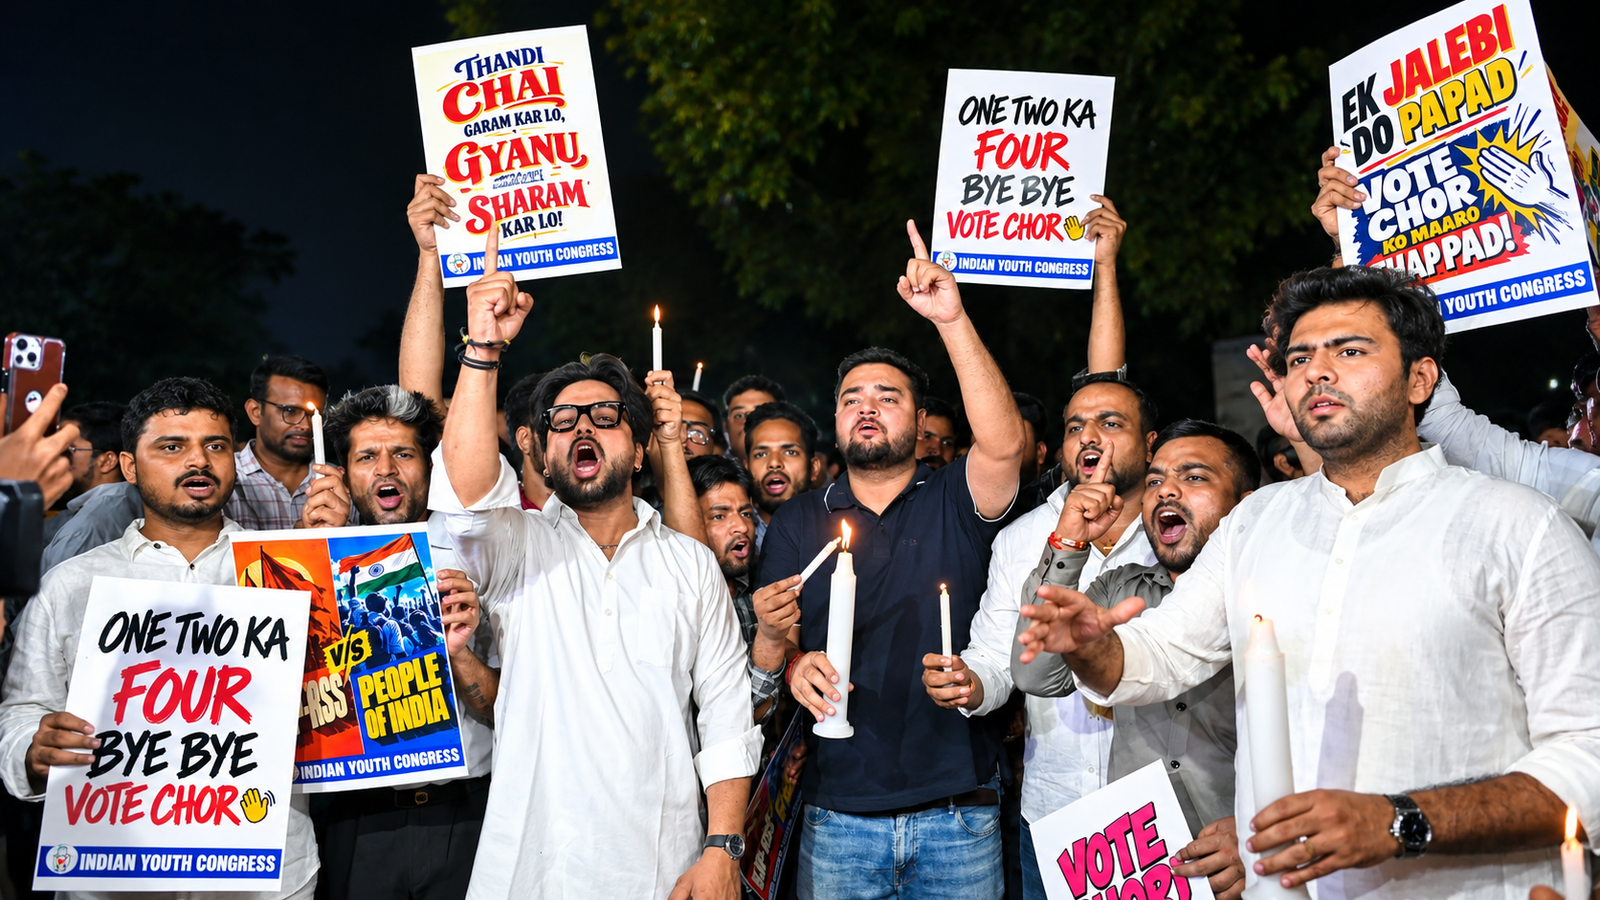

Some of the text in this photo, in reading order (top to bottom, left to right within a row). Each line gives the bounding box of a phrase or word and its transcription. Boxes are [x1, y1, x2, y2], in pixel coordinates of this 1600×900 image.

[454, 47, 544, 80] THANDI
[1341, 73, 1381, 133] EK
[1383, 3, 1516, 108] JALEBI
[442, 66, 566, 123] CHAI
[958, 94, 1097, 130] ONE TWO KA
[1352, 114, 1394, 168] DO
[1397, 57, 1517, 145] PAPAD
[464, 108, 565, 137] GARAM KAR LO,
[444, 132, 588, 185] GYANU
[974, 128, 1070, 171] FOUR
[960, 173, 1075, 208] BYE BYE
[1358, 145, 1458, 215] VOTE
[465, 179, 590, 234] SHARAM
[500, 210, 561, 238] KAR LO!
[947, 209, 1064, 243] VOTE CHOR
[1367, 174, 1479, 242] CHOR
[1382, 206, 1480, 255] KO MAARO
[473, 241, 614, 270] INAN YOUTH CONGRESS
[958, 257, 1089, 275] INDIAN YOUTH CONGRESS
[1370, 214, 1518, 280] HAPPAD!
[1444, 288, 1497, 315] YOUTH
[1500, 269, 1586, 302] CONGRESS
[98, 609, 290, 661] ONE TWO KA
[112, 659, 253, 726] FOUR
[357, 652, 442, 709] PEOPLE
[364, 687, 450, 740] OF INDIA
[86, 730, 259, 779] BYE BYE
[301, 748, 460, 780] INDIAN YOUTH CONGRESS
[65, 781, 242, 826] VOTE CHOR
[79, 852, 276, 872] INDIAN YOUTH CONGRESS
[1057, 801, 1168, 899] VOTE
